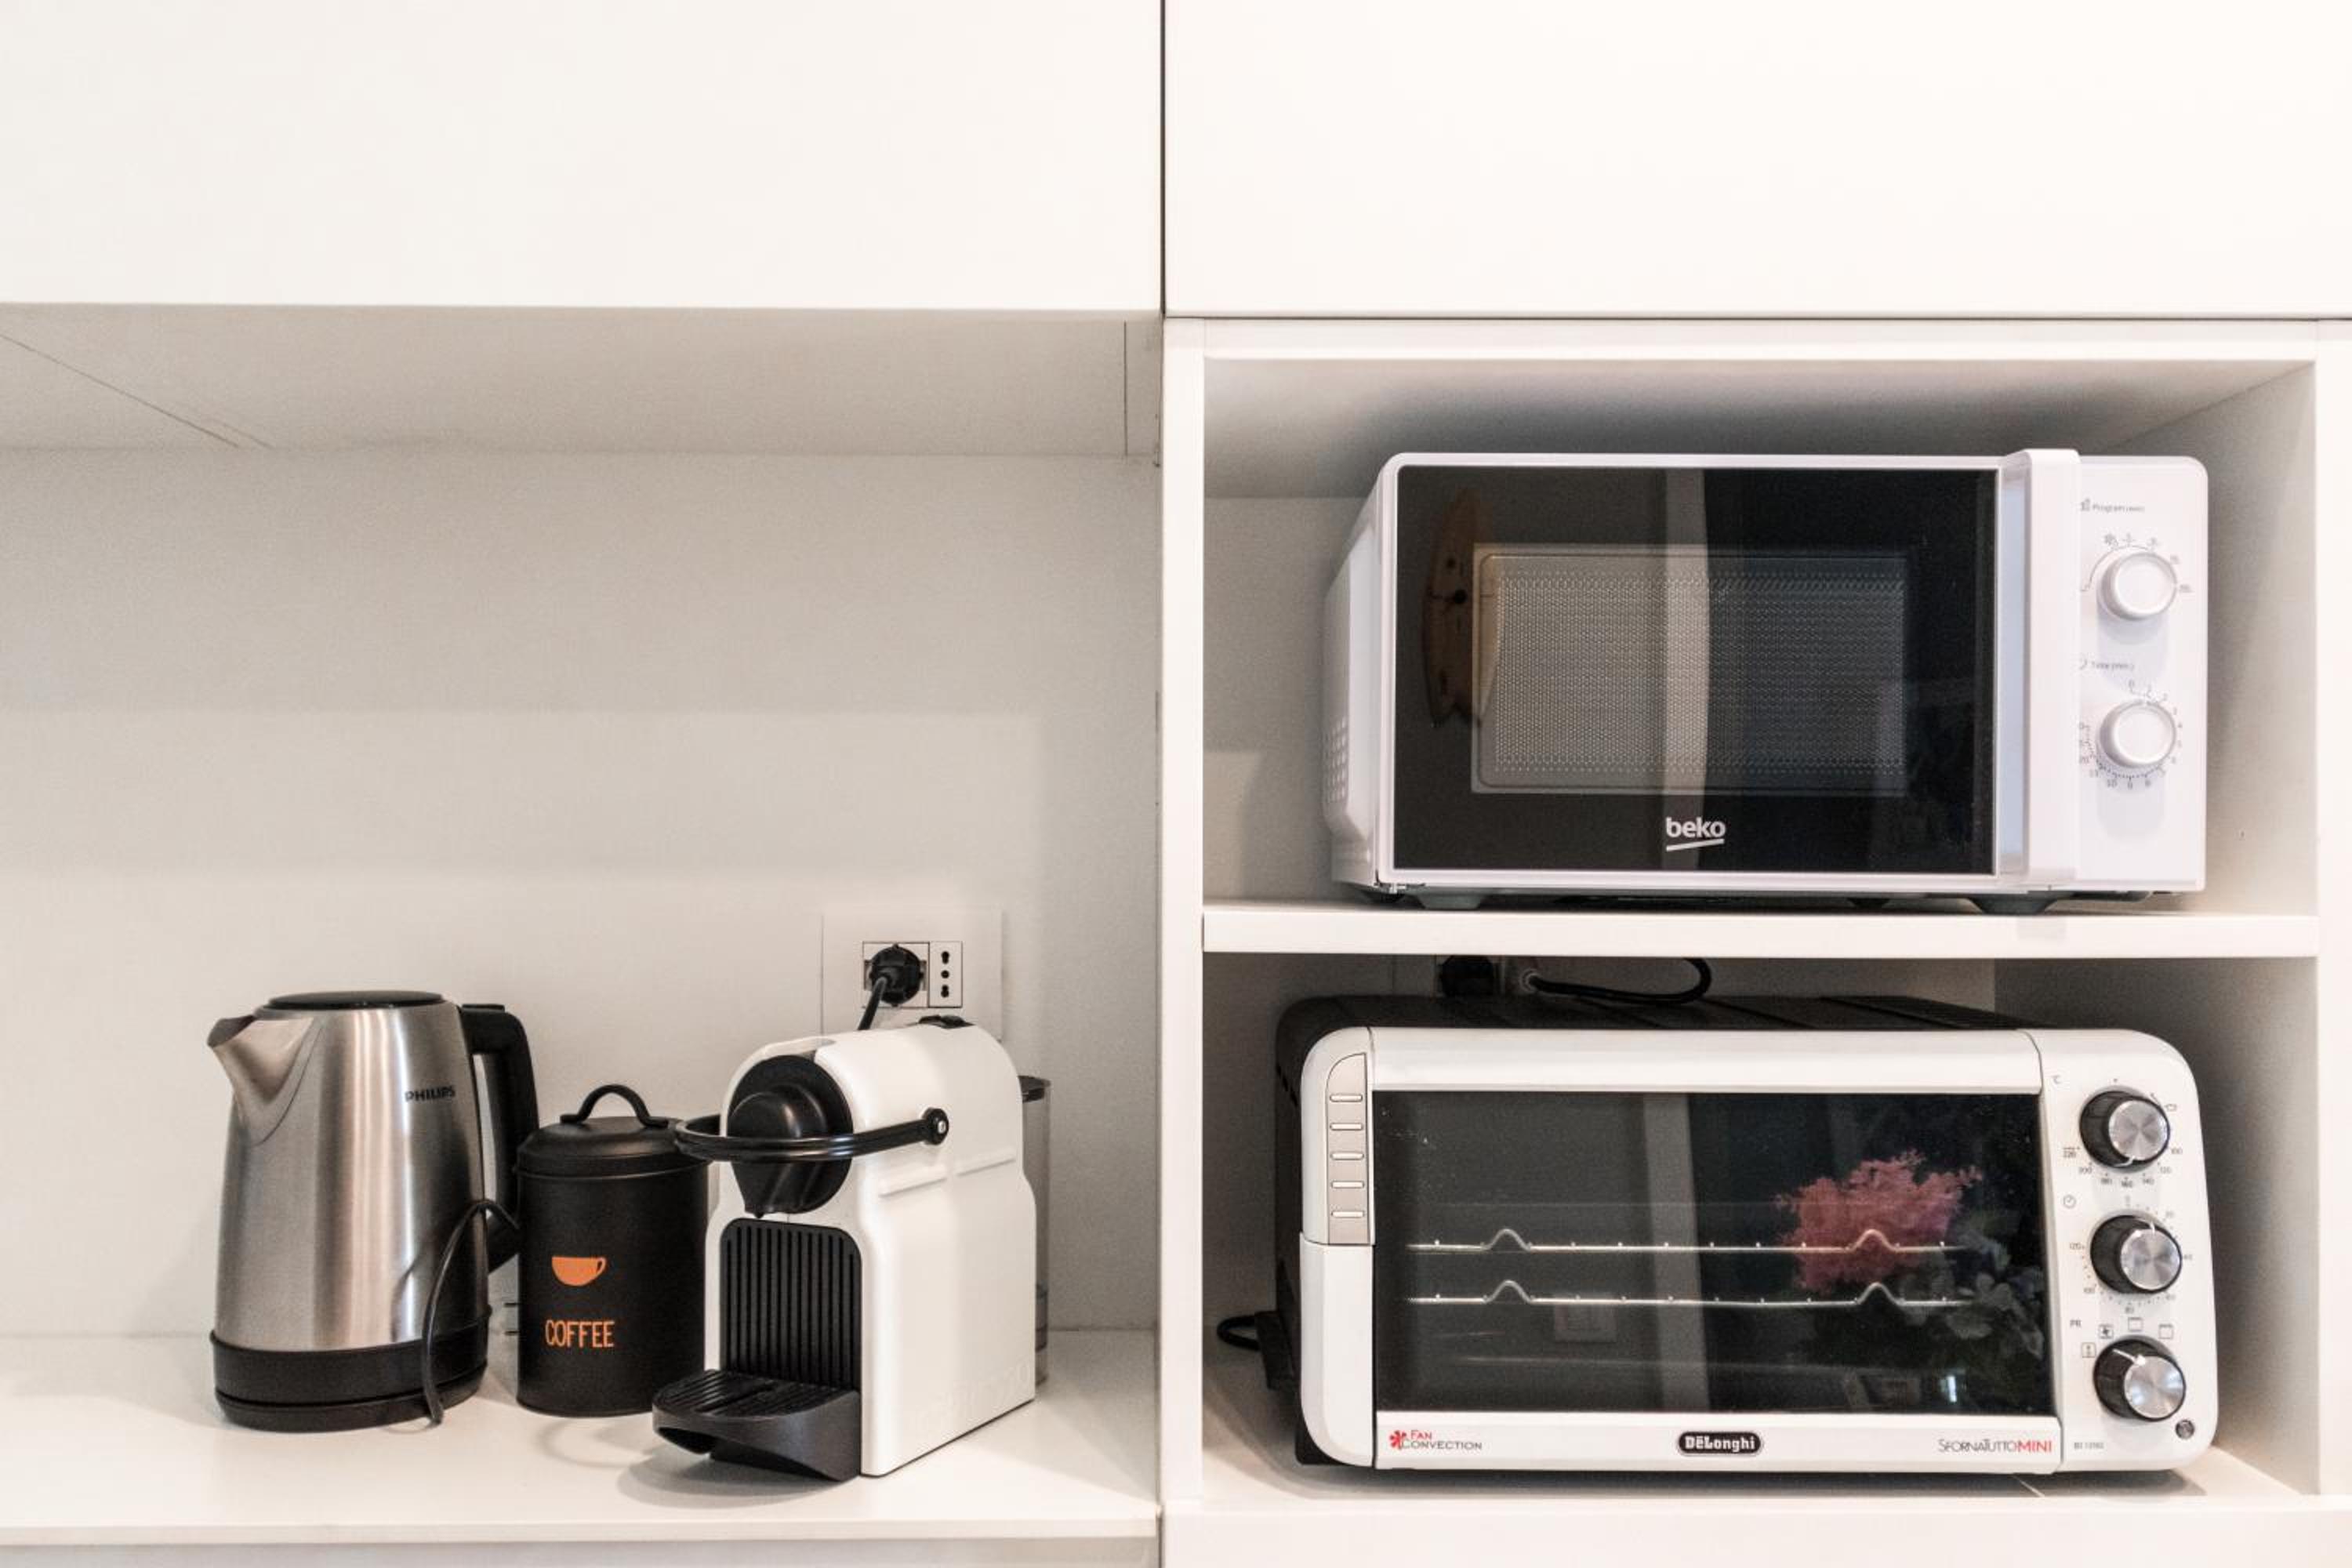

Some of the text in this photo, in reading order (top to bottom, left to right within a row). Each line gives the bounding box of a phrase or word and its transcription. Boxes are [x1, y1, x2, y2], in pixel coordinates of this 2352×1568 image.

[1665, 817, 1726, 838] beko
[405, 1086, 456, 1102] PHILIPS
[545, 1319, 615, 1348] COFFEE
[1410, 1430, 1432, 1440] FAN
[1402, 1439, 1483, 1450] CONVECTION
